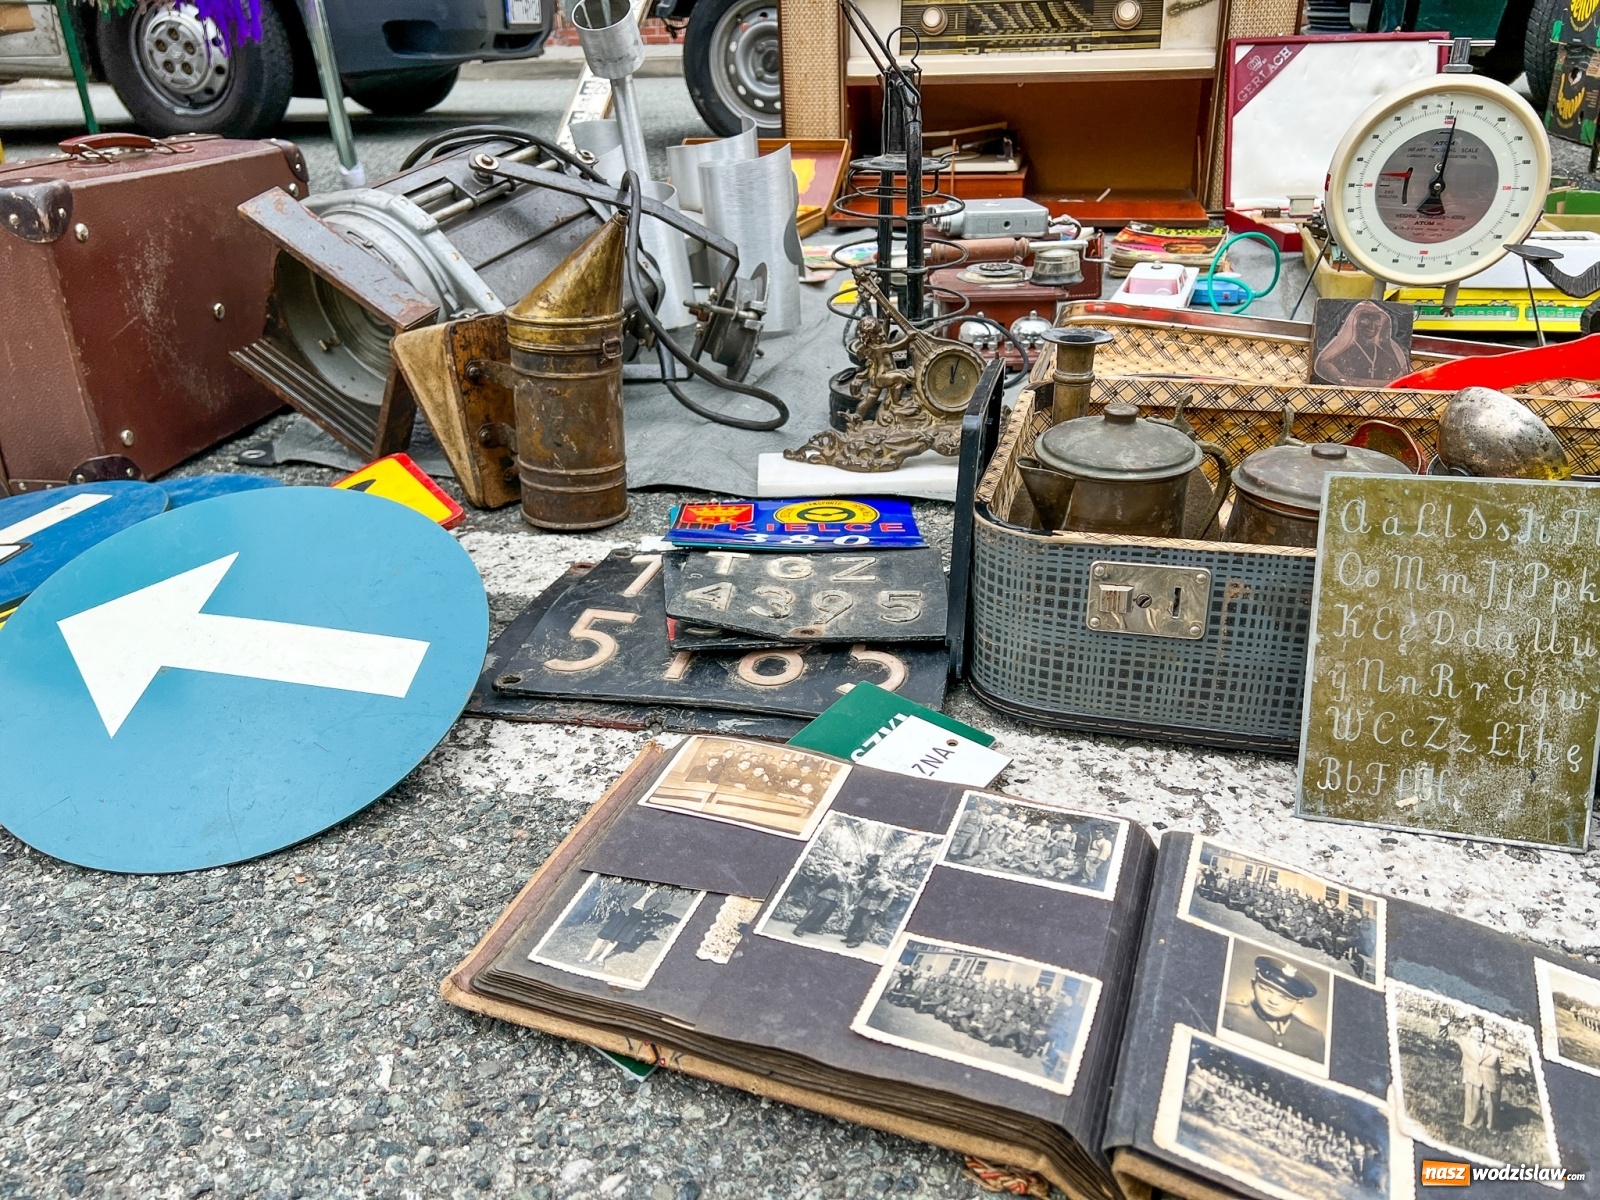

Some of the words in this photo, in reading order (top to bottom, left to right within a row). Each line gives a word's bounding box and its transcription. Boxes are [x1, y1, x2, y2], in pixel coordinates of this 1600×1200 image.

[1237, 46, 1293, 102] GERLACH
[695, 515, 737, 524] CK
[729, 522, 906, 532] KIELCE
[741, 533, 870, 545] 380
[706, 551, 876, 582] TGZ
[685, 582, 922, 624] 4395
